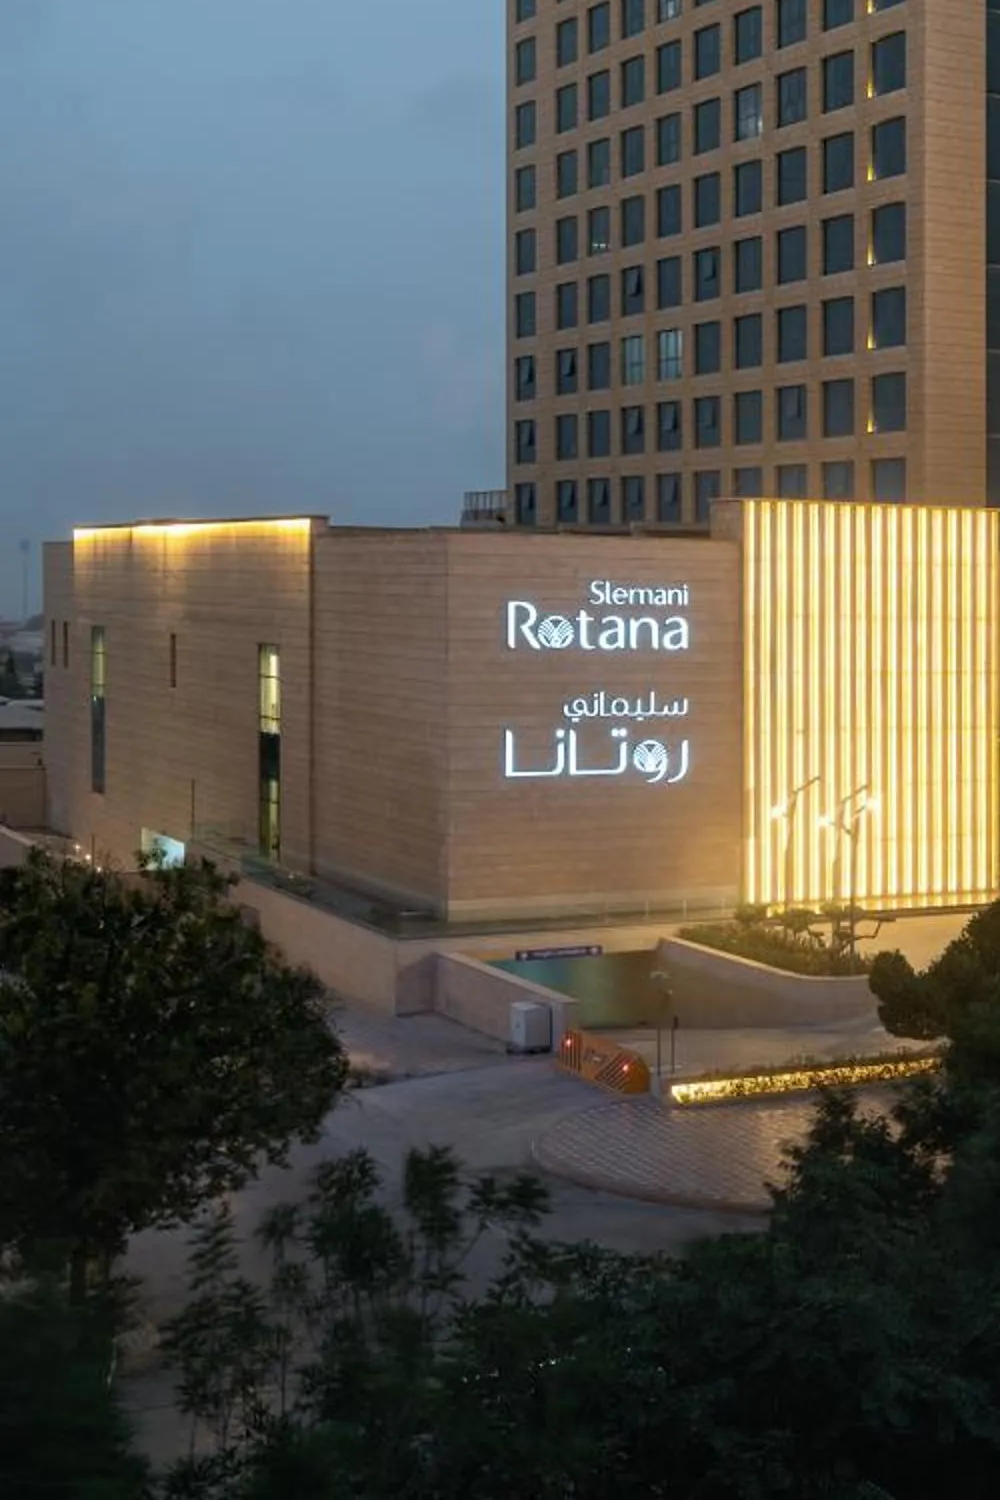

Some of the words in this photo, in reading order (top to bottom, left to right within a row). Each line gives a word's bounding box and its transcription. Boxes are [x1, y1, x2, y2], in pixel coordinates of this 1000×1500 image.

[589, 580, 690, 606] Slemani
[507, 600, 690, 651] Rotana
[504, 727, 689, 784] روتانا
